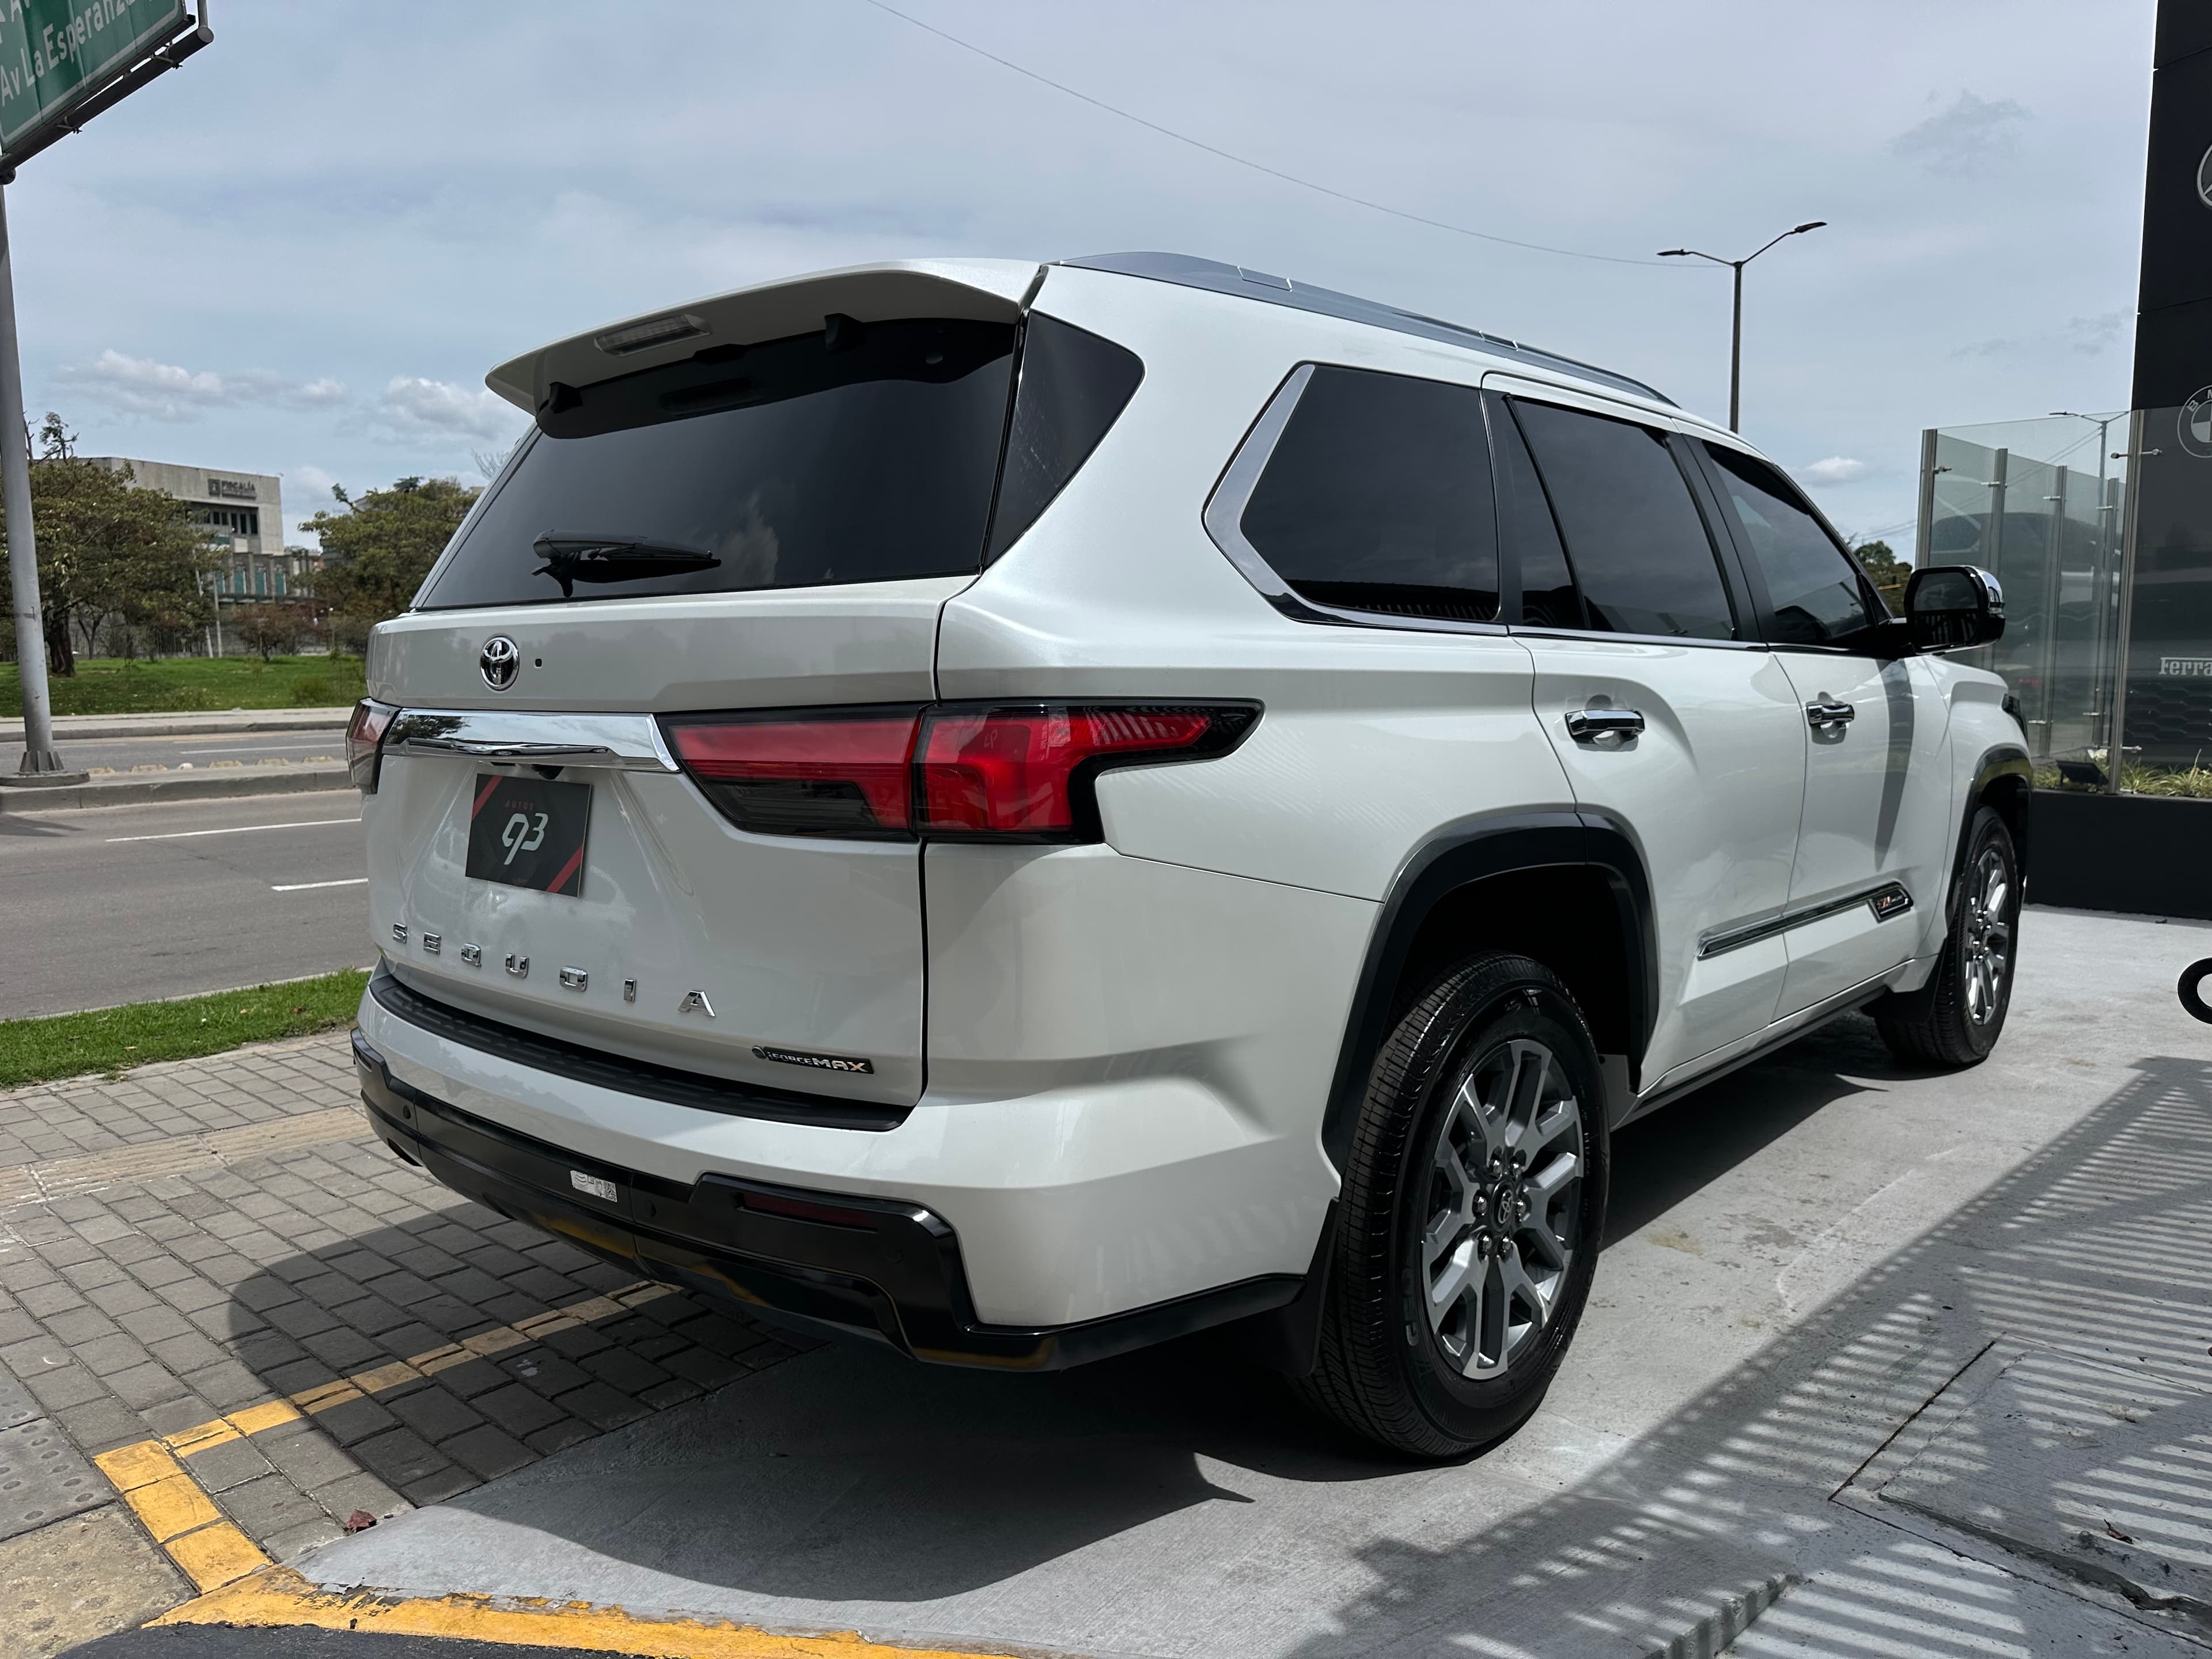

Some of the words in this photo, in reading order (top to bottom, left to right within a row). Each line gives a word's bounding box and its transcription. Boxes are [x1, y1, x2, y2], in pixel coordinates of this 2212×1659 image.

[1, 64, 21, 107] Av
[20, 47, 45, 88] La
[43, 0, 137, 70] Esperanz
[502, 813, 548, 865] 93
[505, 800, 535, 811] AUTOS
[392, 922, 717, 1018] SEQUOIA
